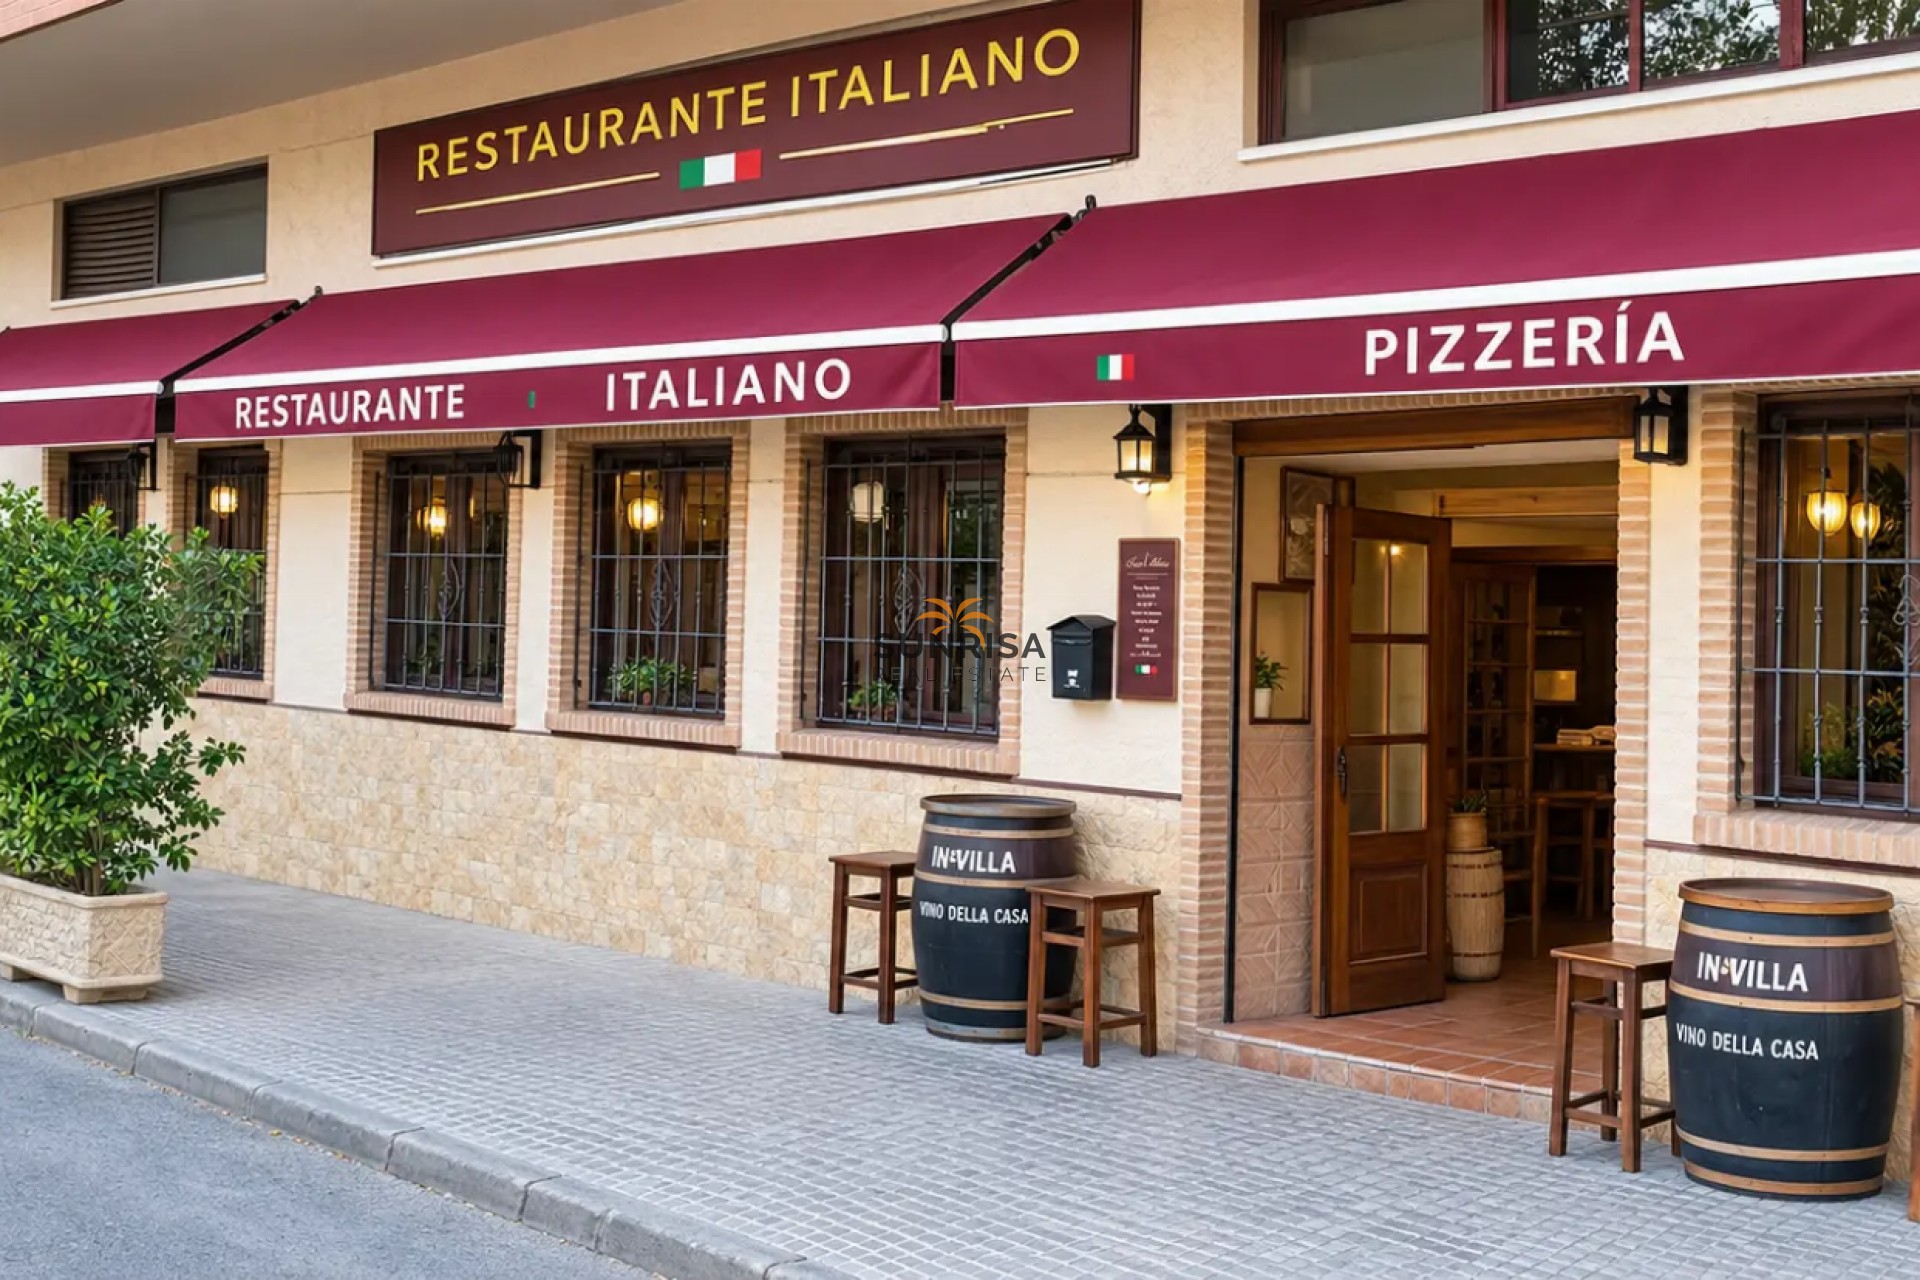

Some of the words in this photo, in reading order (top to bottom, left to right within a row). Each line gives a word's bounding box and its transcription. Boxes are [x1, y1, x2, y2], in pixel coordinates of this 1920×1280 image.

[416, 80, 767, 181] RESTAURANTE
[790, 28, 1081, 117] ITALIANO
[1365, 302, 1685, 375] PIZZERÍA
[234, 383, 465, 429] RESTAURANTE
[605, 358, 852, 411] ITALIANO
[919, 901, 944, 919] VINO
[948, 905, 989, 924] DELLA
[994, 908, 1029, 924] CASA
[1676, 1022, 1707, 1048] VINO
[1712, 1030, 1764, 1057] DELLA
[1770, 1038, 1819, 1060] CASA
